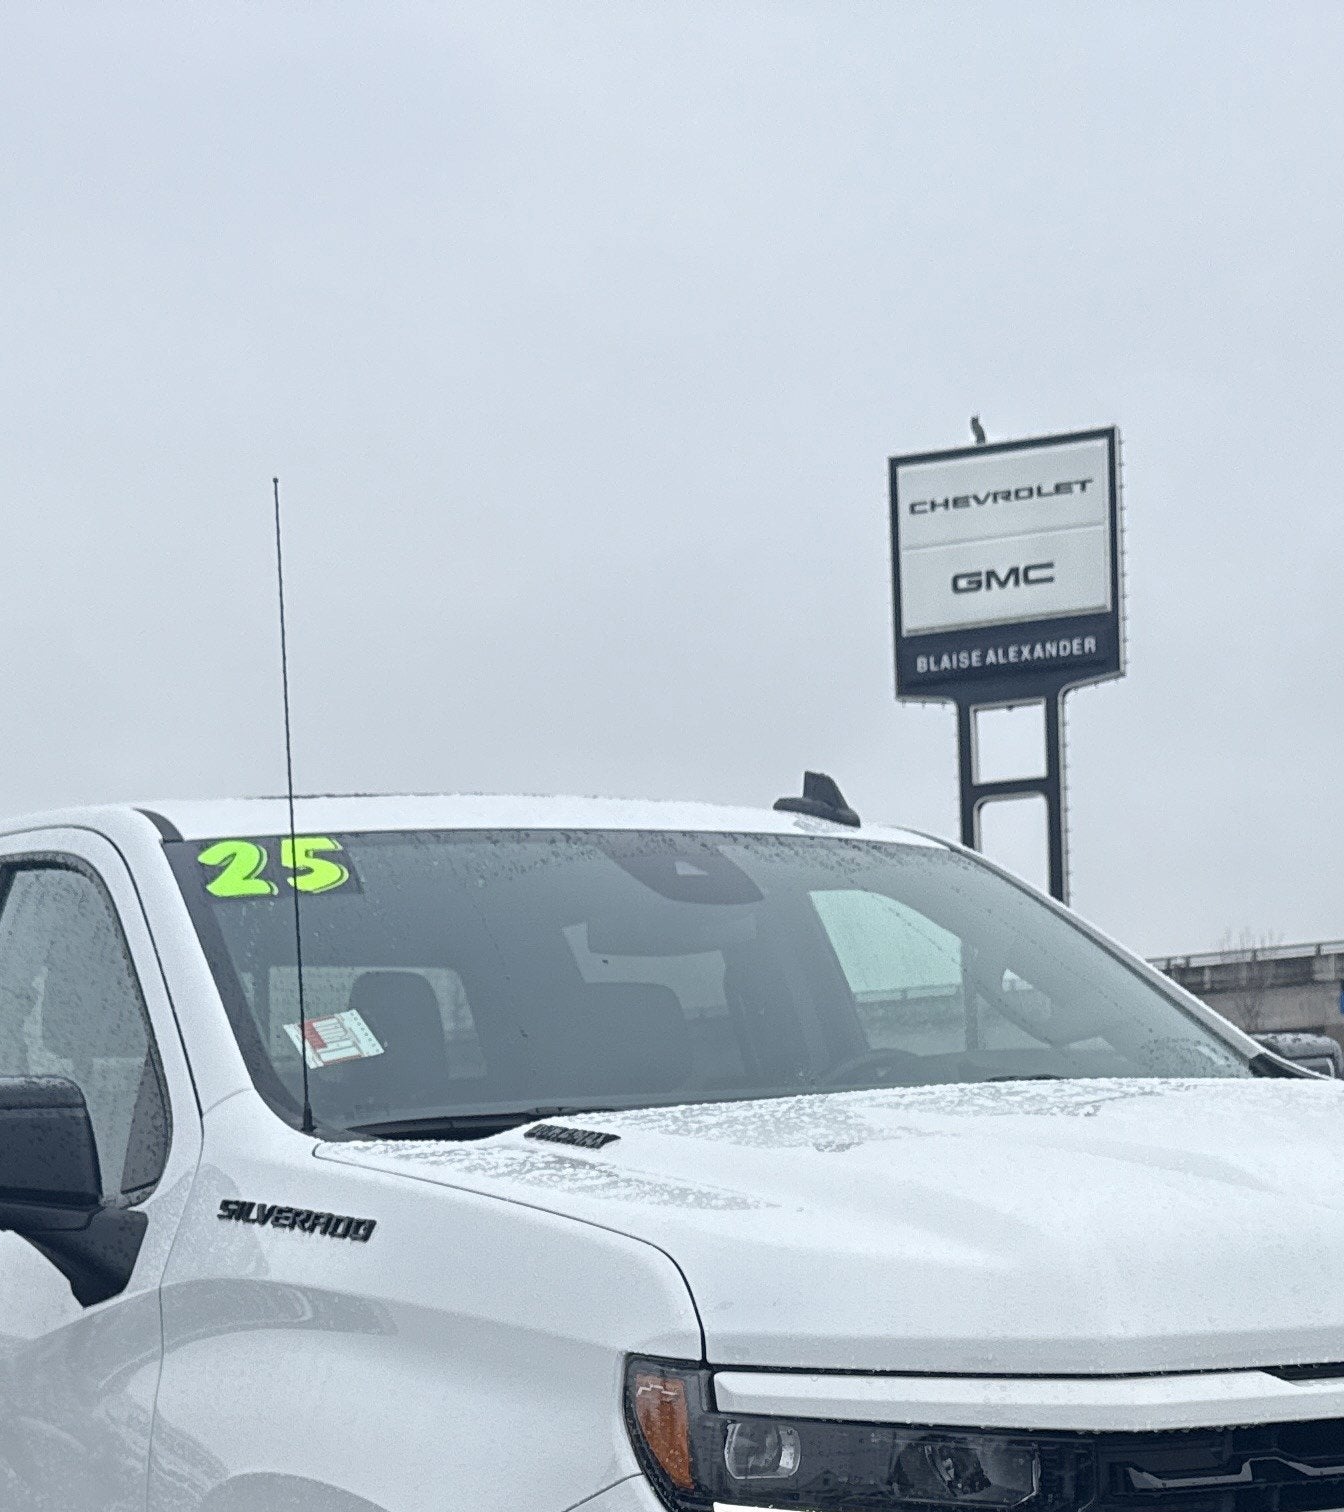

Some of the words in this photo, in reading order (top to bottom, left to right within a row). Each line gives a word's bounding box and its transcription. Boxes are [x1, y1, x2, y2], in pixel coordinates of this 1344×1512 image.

[909, 478, 1093, 516] CHEVROLET
[952, 561, 1055, 594] GMC
[916, 649, 982, 673] BLAISE
[985, 636, 1097, 665] ALEXANDER
[197, 837, 349, 897] 25
[217, 1199, 377, 1243] SILVERADO
